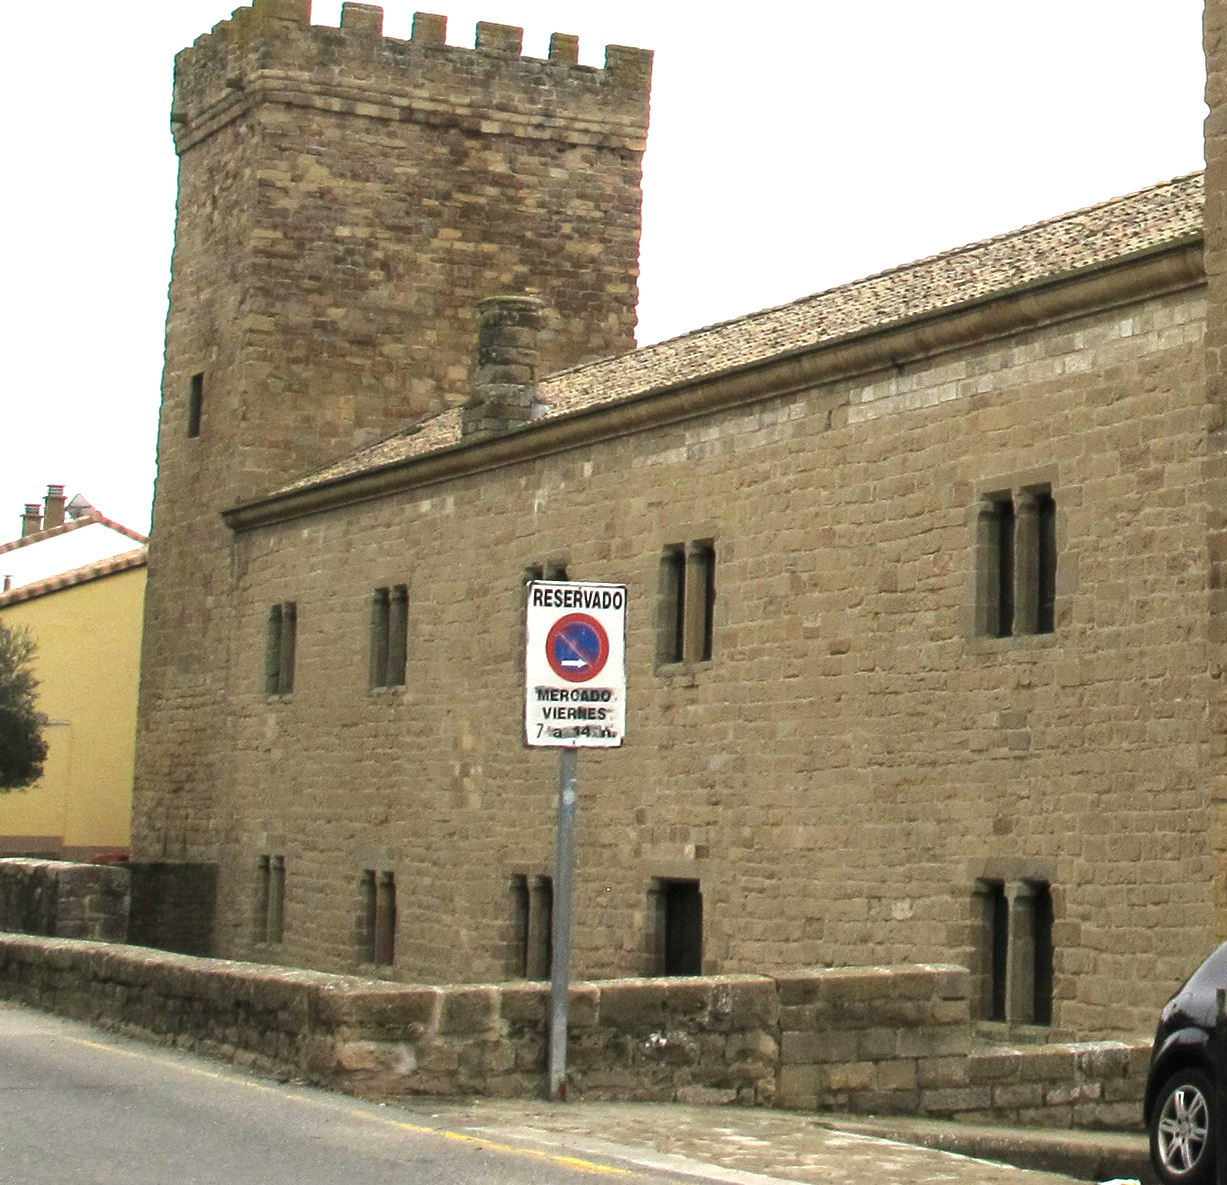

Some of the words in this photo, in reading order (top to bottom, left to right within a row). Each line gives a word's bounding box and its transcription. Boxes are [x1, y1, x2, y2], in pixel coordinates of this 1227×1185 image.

[533, 588, 623, 610] RESERVADO
[537, 688, 611, 702] MERCADO
[542, 706, 607, 720] VIERNES
[536, 723, 544, 738] 7
[553, 727, 562, 738] a
[575, 725, 591, 738] 14
